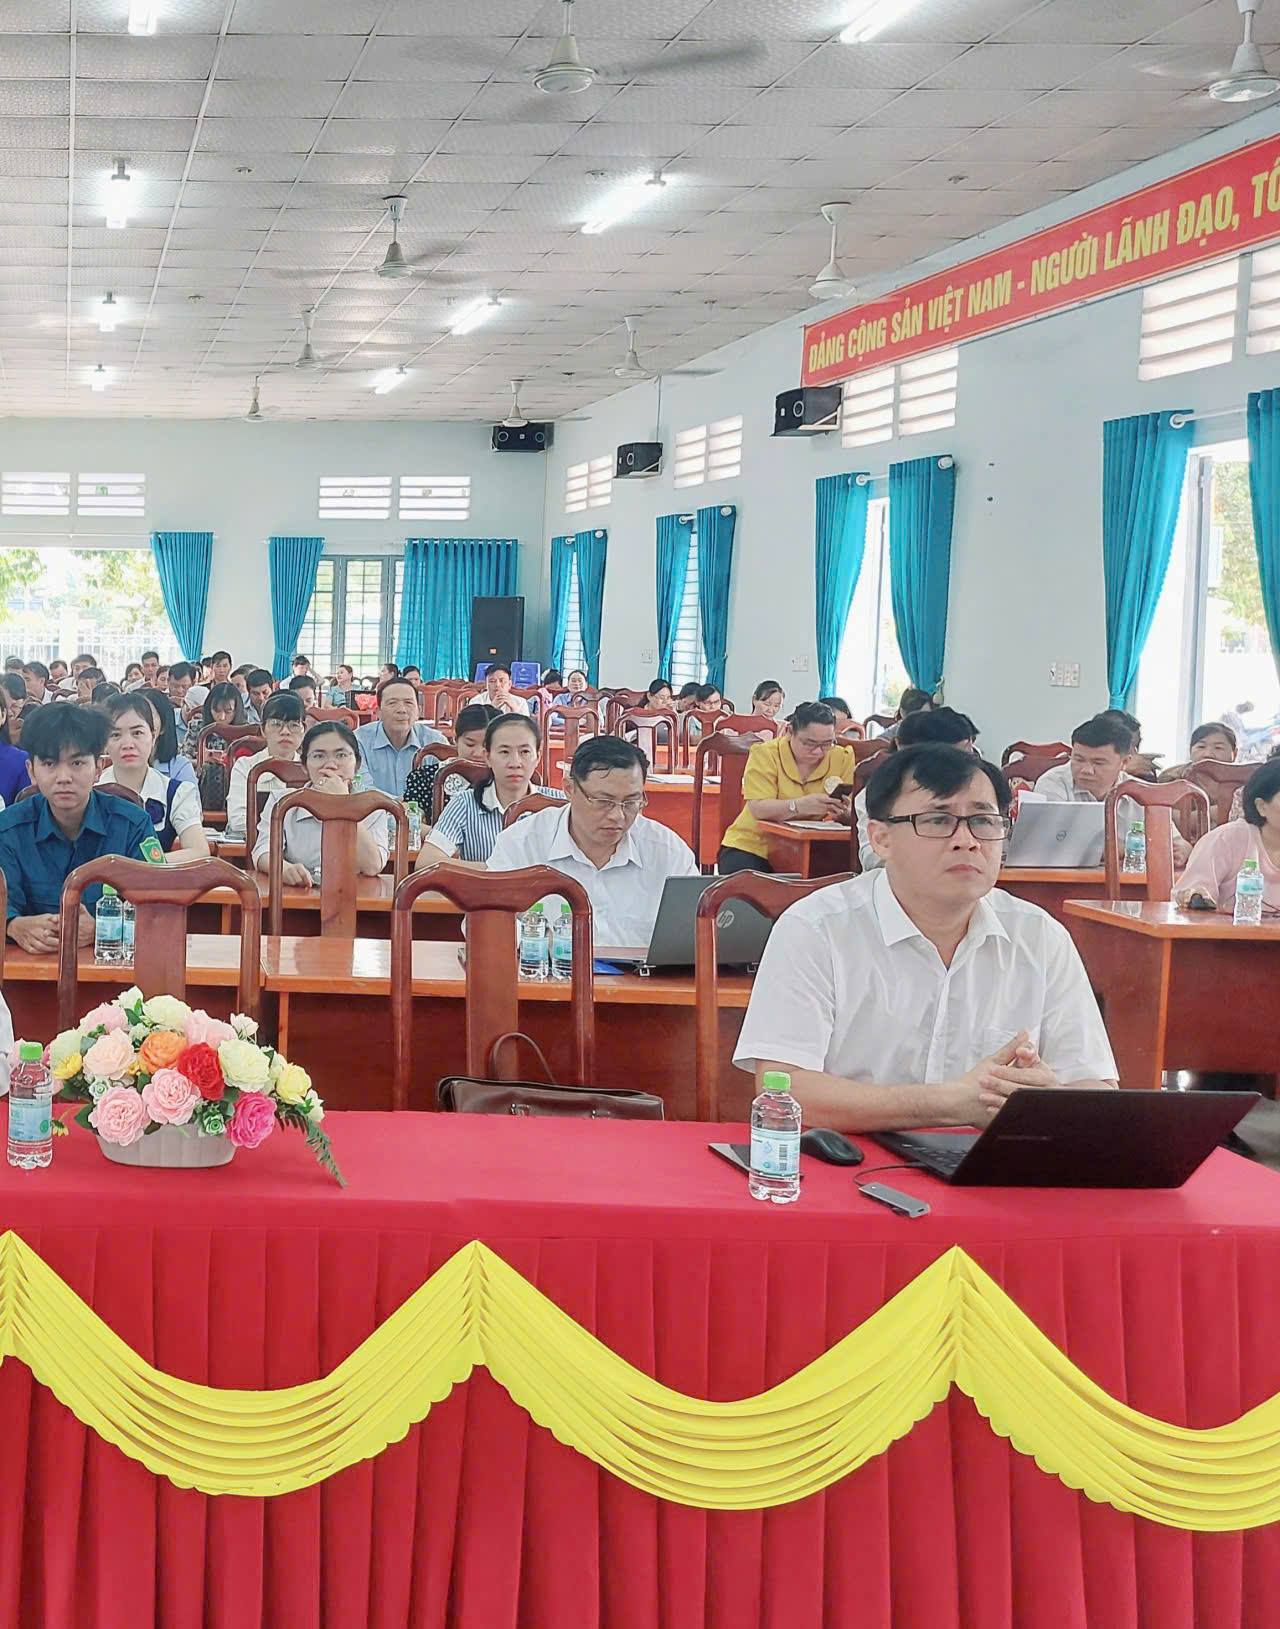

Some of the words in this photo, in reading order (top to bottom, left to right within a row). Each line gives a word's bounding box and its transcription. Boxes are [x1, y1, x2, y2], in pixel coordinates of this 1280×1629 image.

[808, 331, 845, 373] ĐẢNG
[847, 319, 888, 362] CỘNG
[891, 297, 924, 344] SẢN
[928, 285, 964, 333] VIỆT
[967, 270, 1012, 318] NAM
[1030, 232, 1099, 296] NGƯỜI
[1104, 208, 1170, 270] LÃNH
[1176, 186, 1240, 247] ĐẠO,
